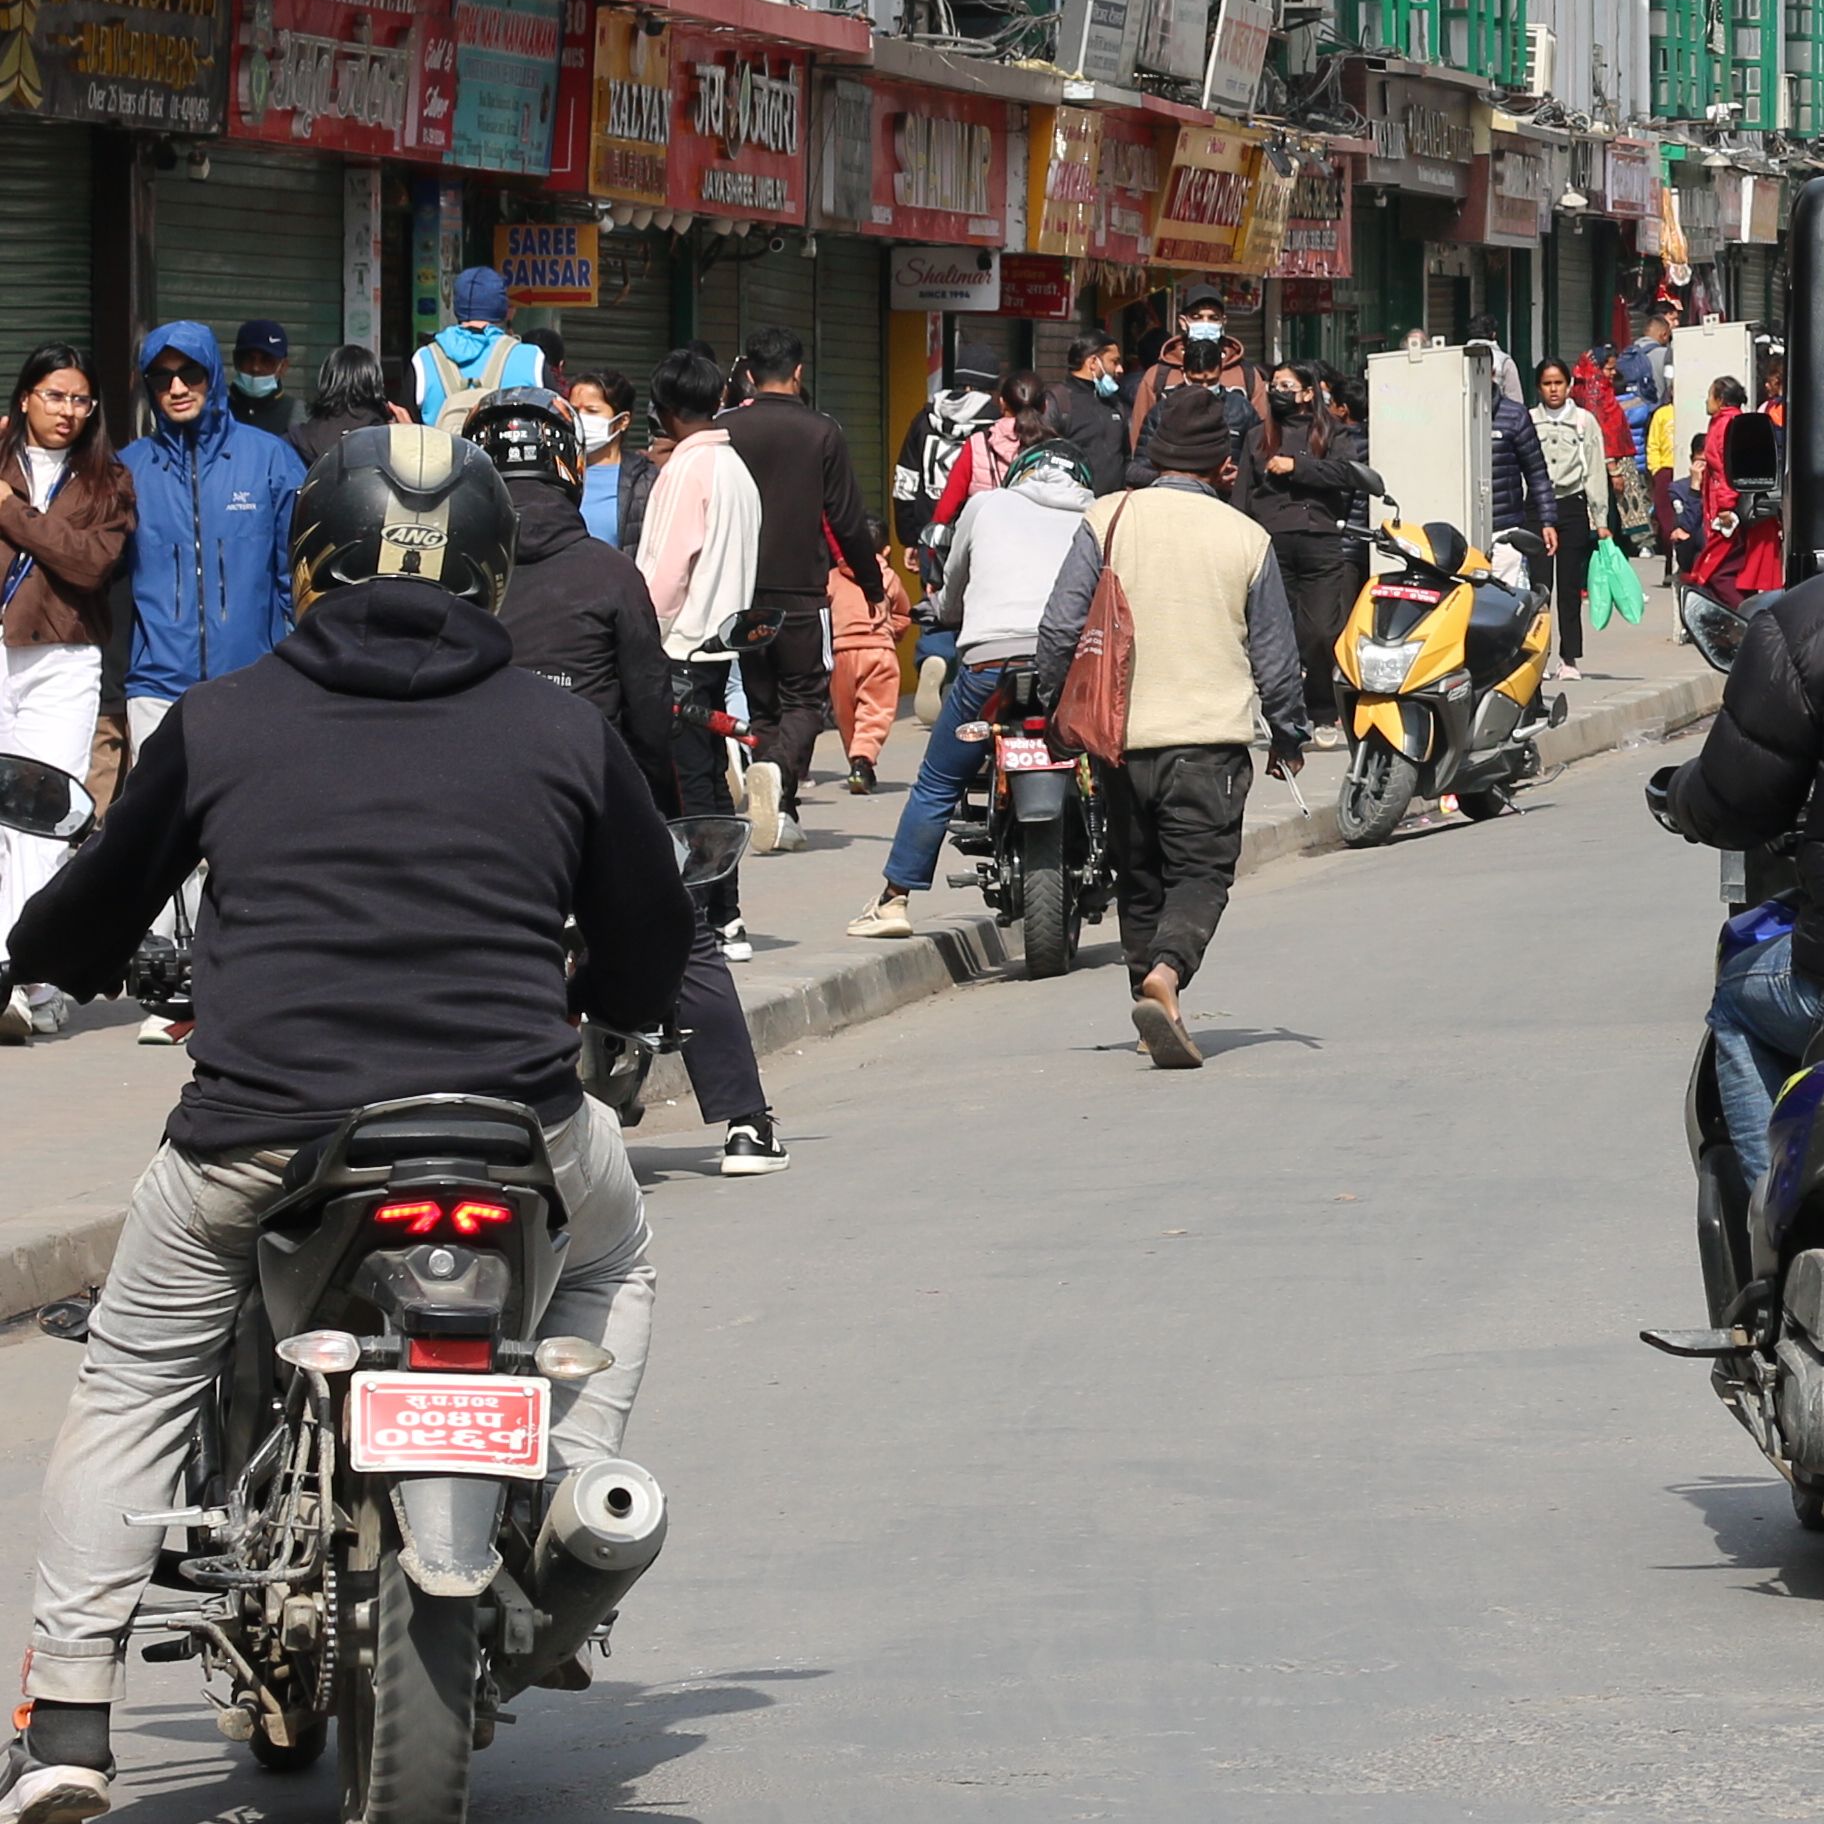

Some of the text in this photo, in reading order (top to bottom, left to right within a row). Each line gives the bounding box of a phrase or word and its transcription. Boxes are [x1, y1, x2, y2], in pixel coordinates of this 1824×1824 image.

[607, 78, 673, 145] KALYAN
[508, 227, 577, 256] SAREE
[502, 258, 592, 288] SANSAR
[896, 258, 993, 288] Shalimar
